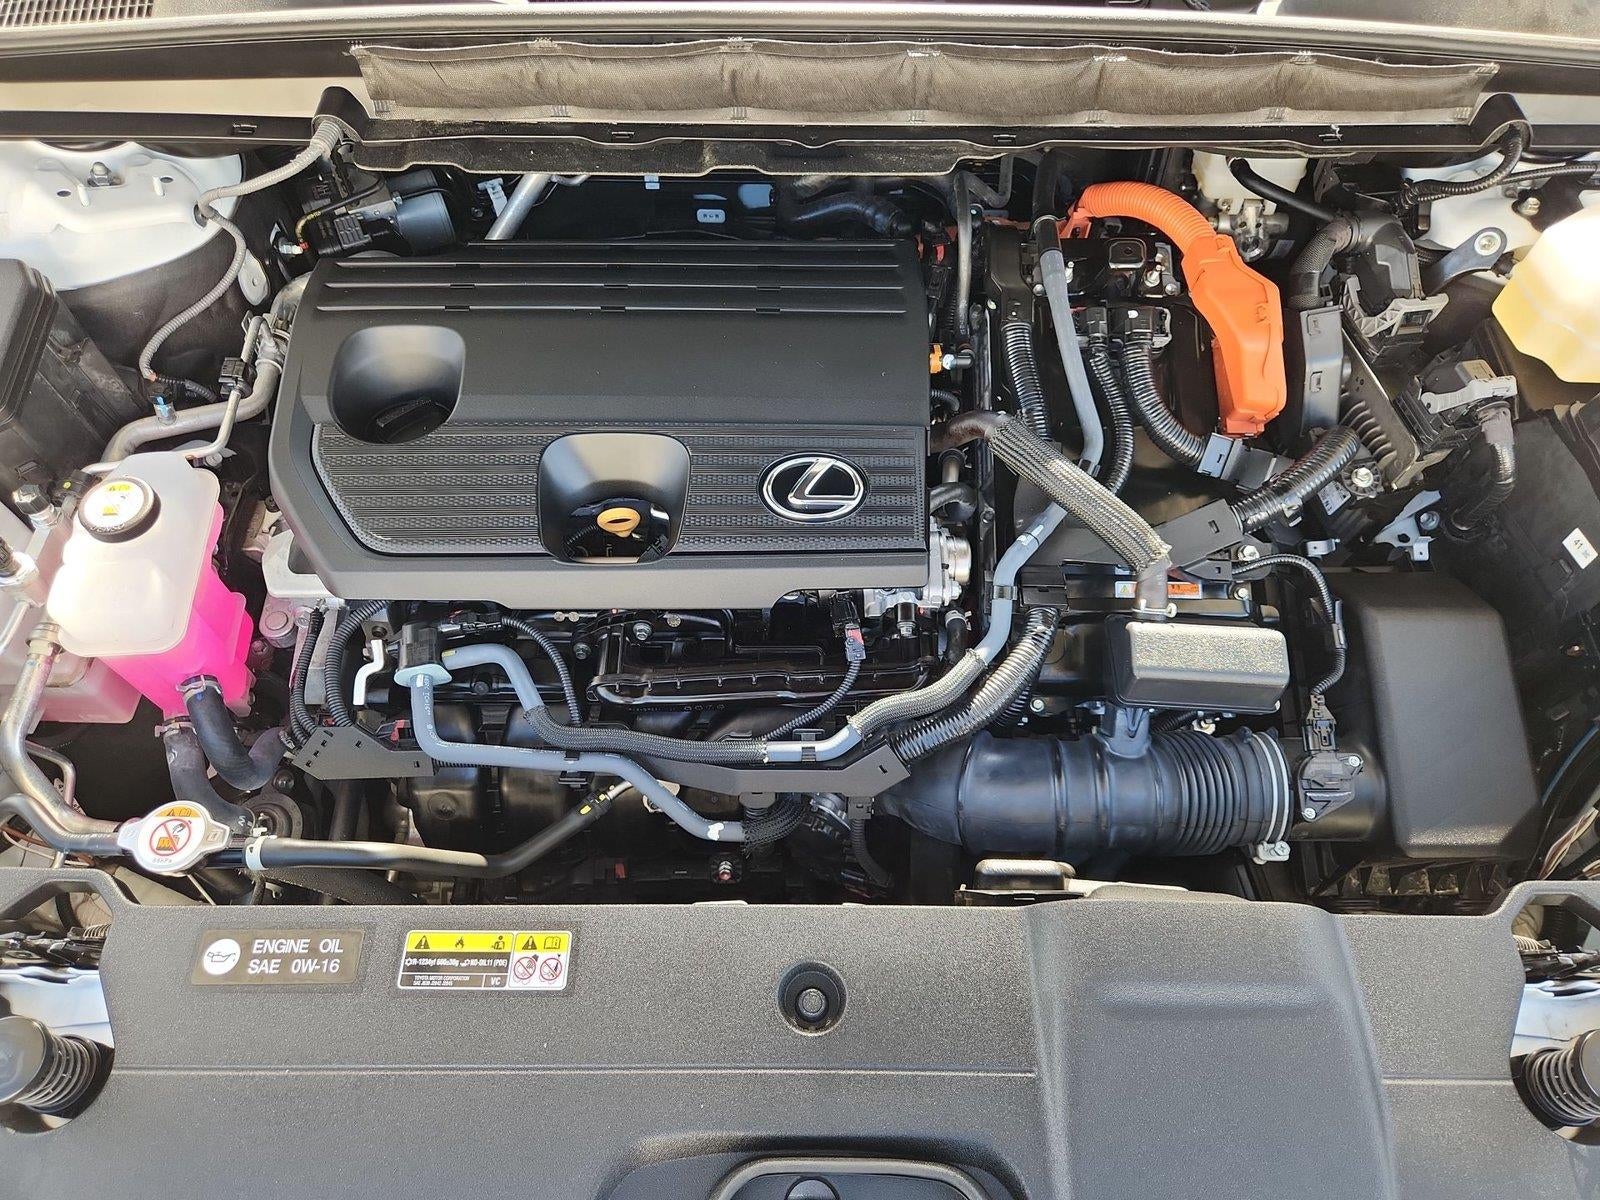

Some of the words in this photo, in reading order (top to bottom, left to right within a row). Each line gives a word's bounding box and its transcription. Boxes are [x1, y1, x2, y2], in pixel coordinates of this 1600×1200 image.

[252, 938, 311, 954] ENGINE
[319, 938, 344, 954] OIL
[248, 958, 282, 974] SAE
[290, 958, 341, 974] 0W-16
[490, 977, 501, 986] VC
